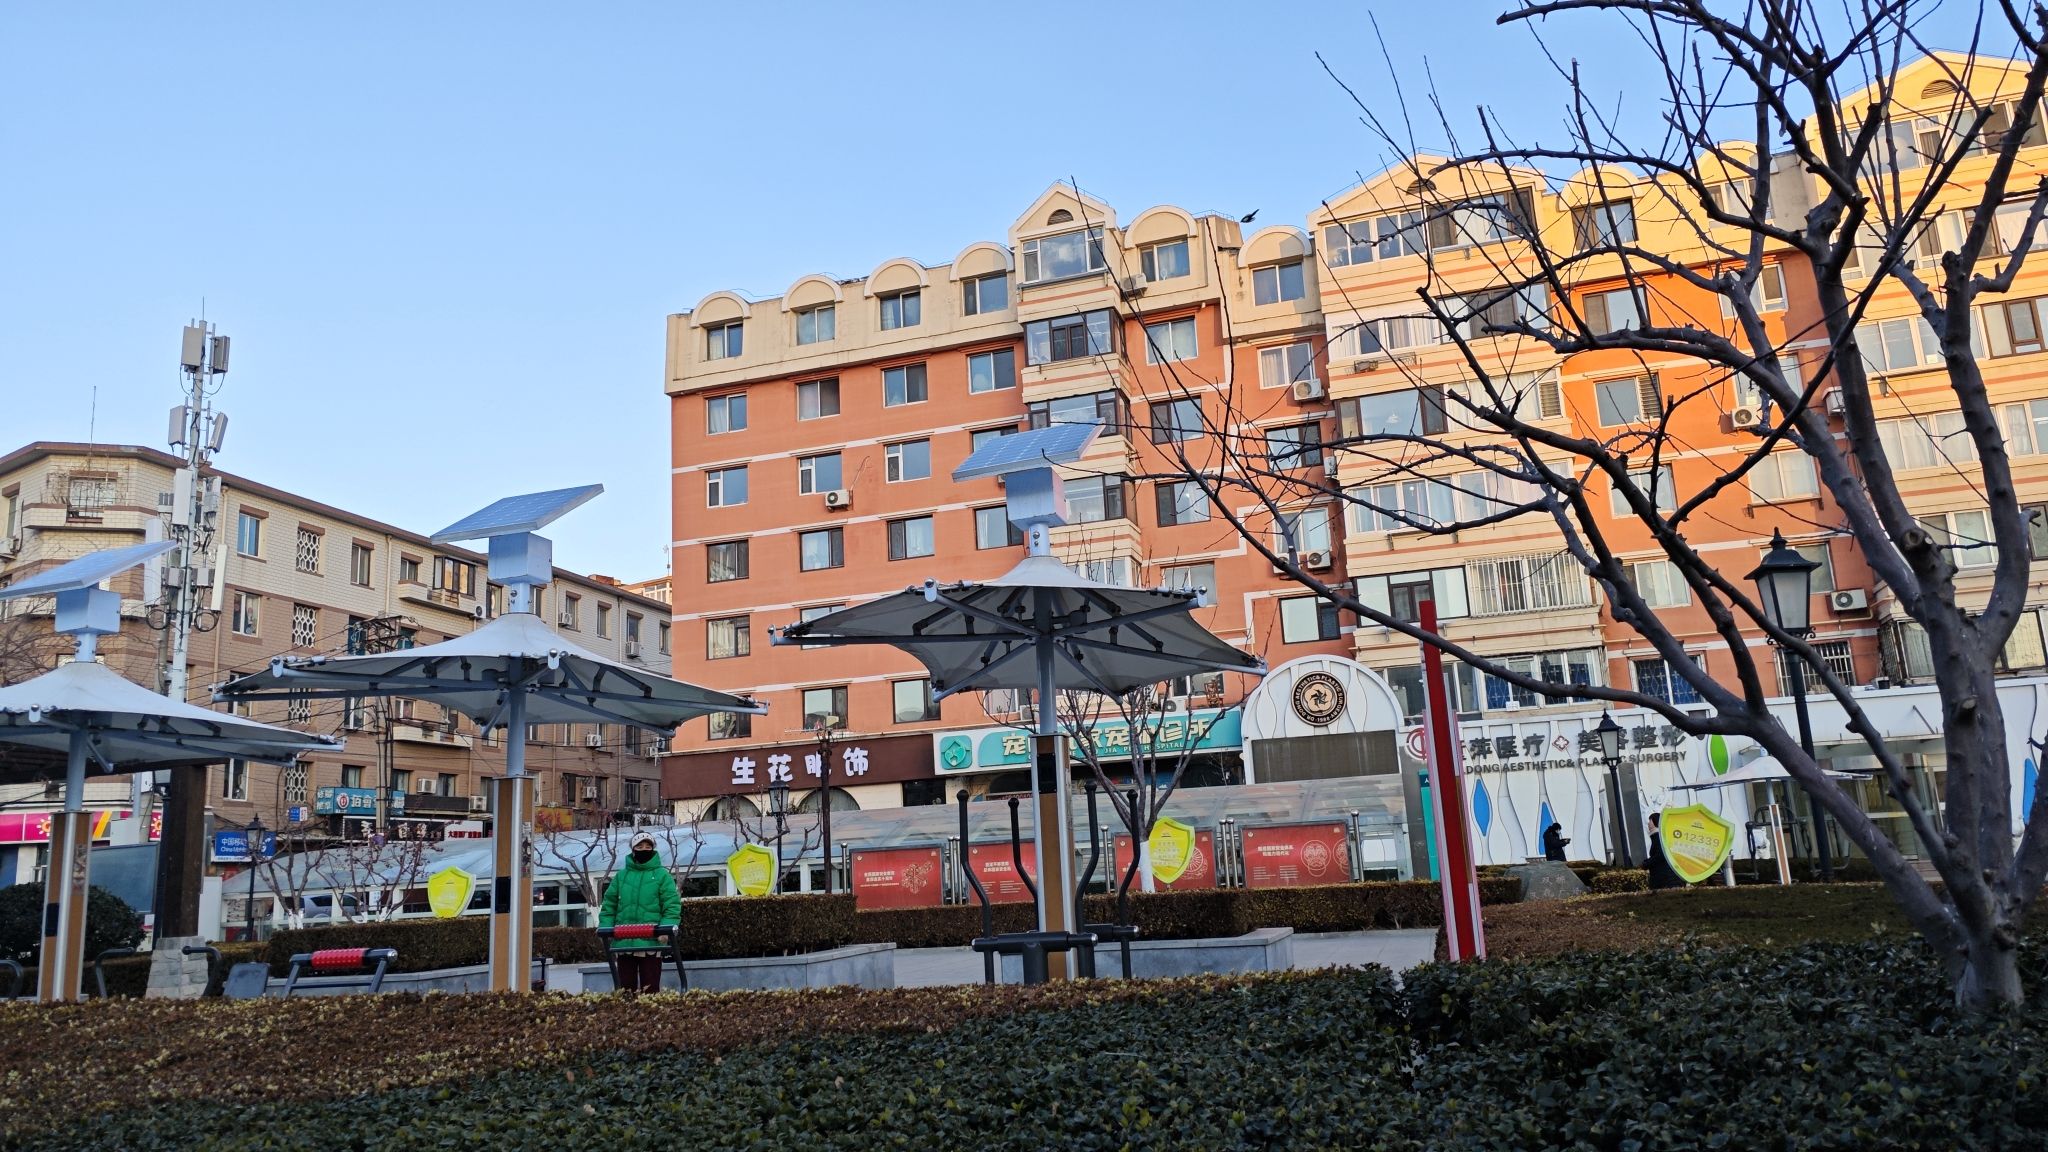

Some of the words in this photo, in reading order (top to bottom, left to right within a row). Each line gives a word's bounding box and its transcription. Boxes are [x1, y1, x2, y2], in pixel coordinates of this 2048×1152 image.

[1144, 742, 1184, 751] HSPITAL
[1459, 733, 1546, 760] 萍医疗
[1628, 751, 1687, 763] SURGERY
[1684, 832, 1720, 848] 12339
